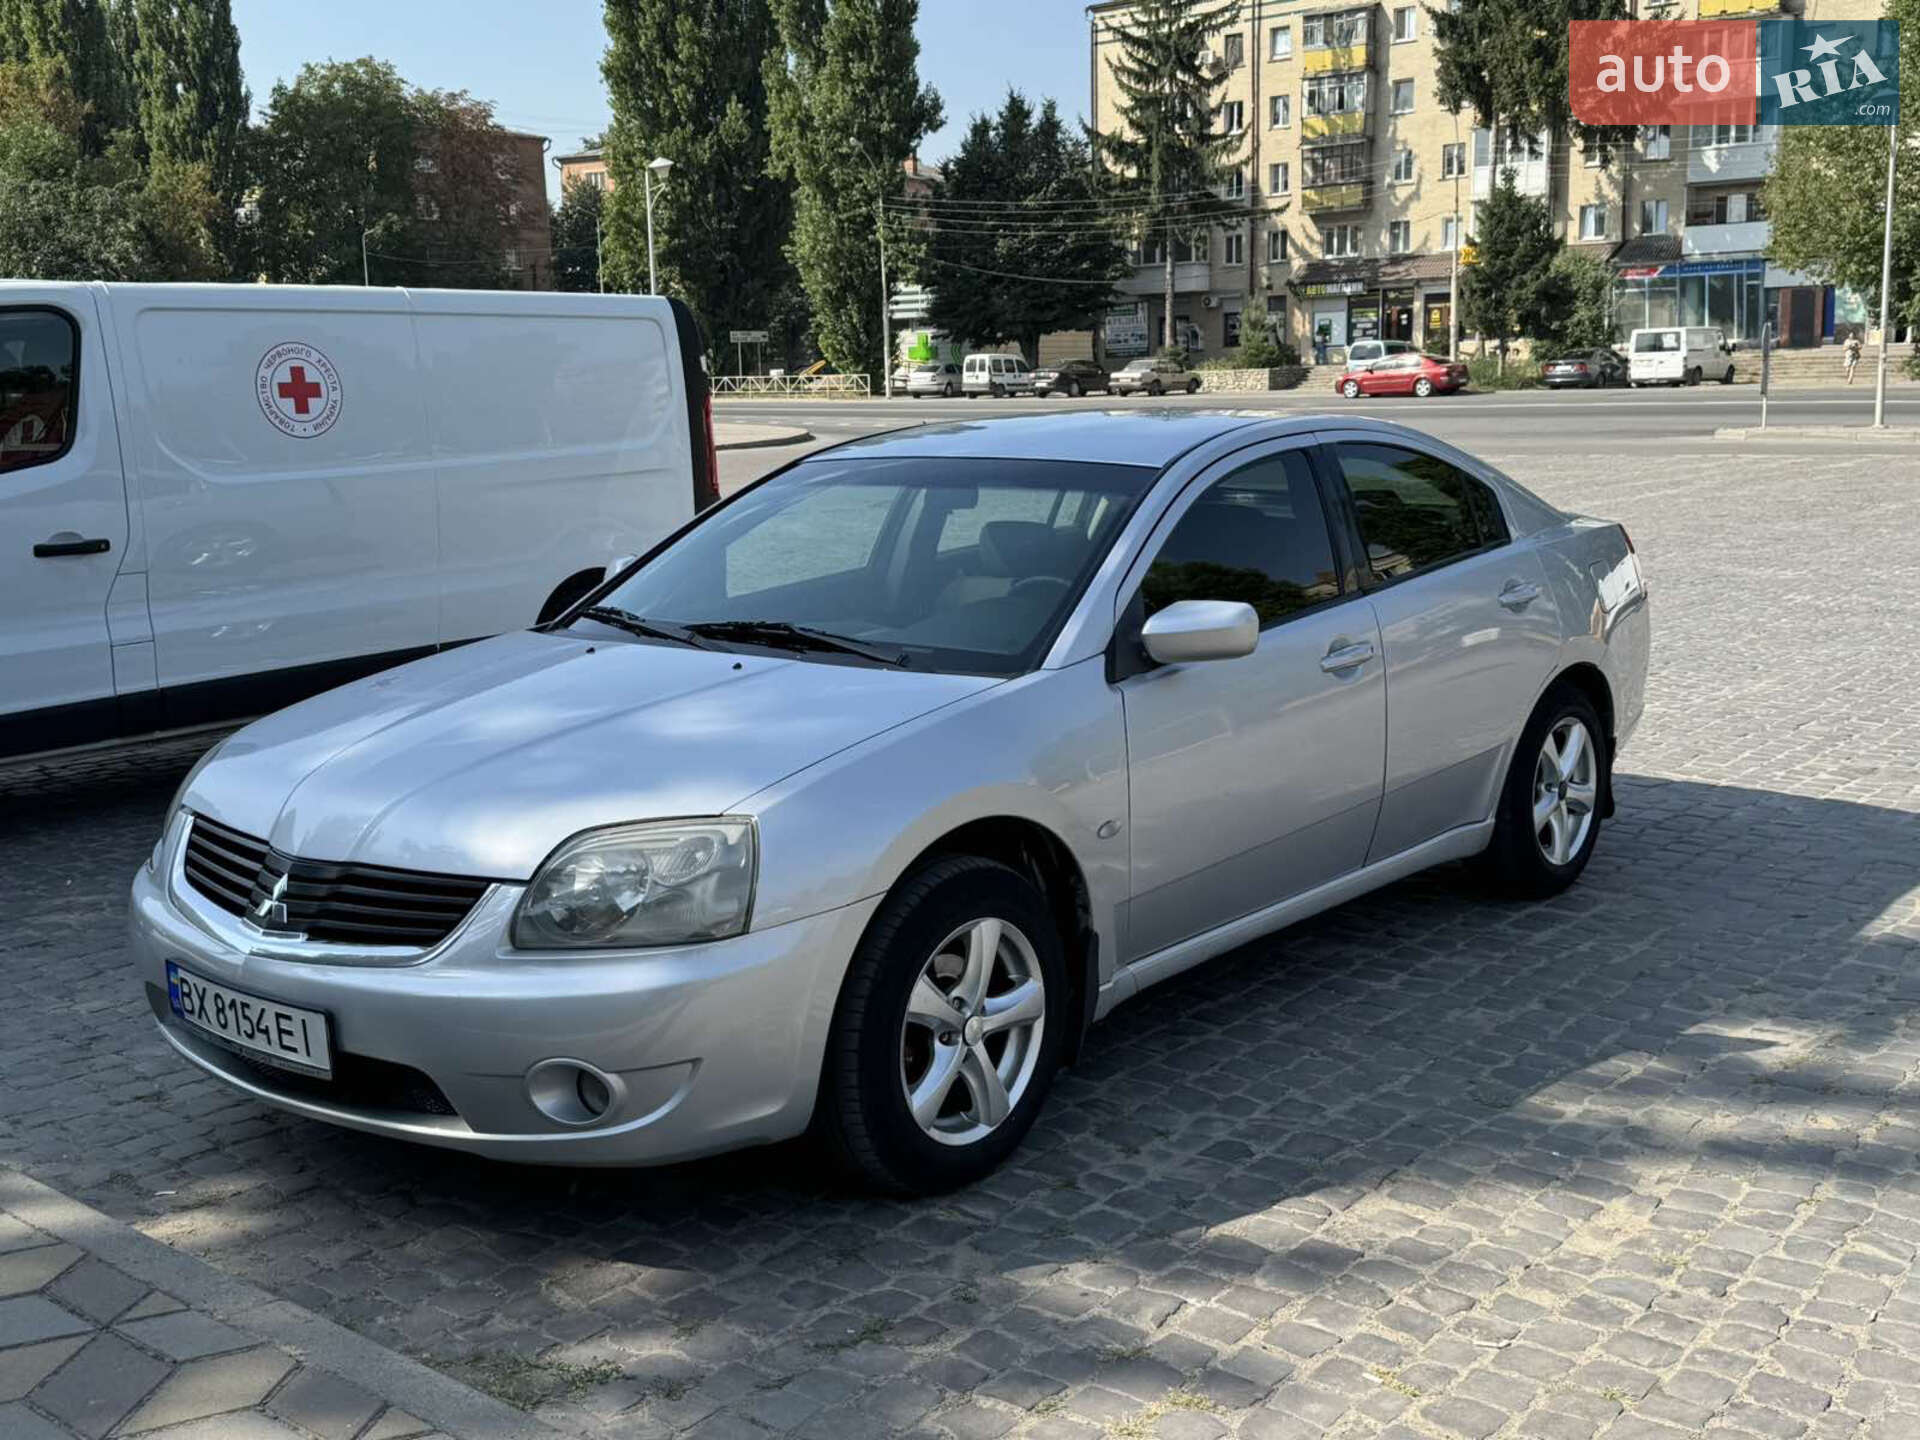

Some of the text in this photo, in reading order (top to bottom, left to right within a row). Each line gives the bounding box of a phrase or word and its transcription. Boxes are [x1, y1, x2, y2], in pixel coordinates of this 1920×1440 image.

[264, 347, 312, 369] ЧЕРВОНОГО
[315, 356, 338, 392] ХРЕСТА
[260, 376, 295, 432] ТОВАРИСТВО
